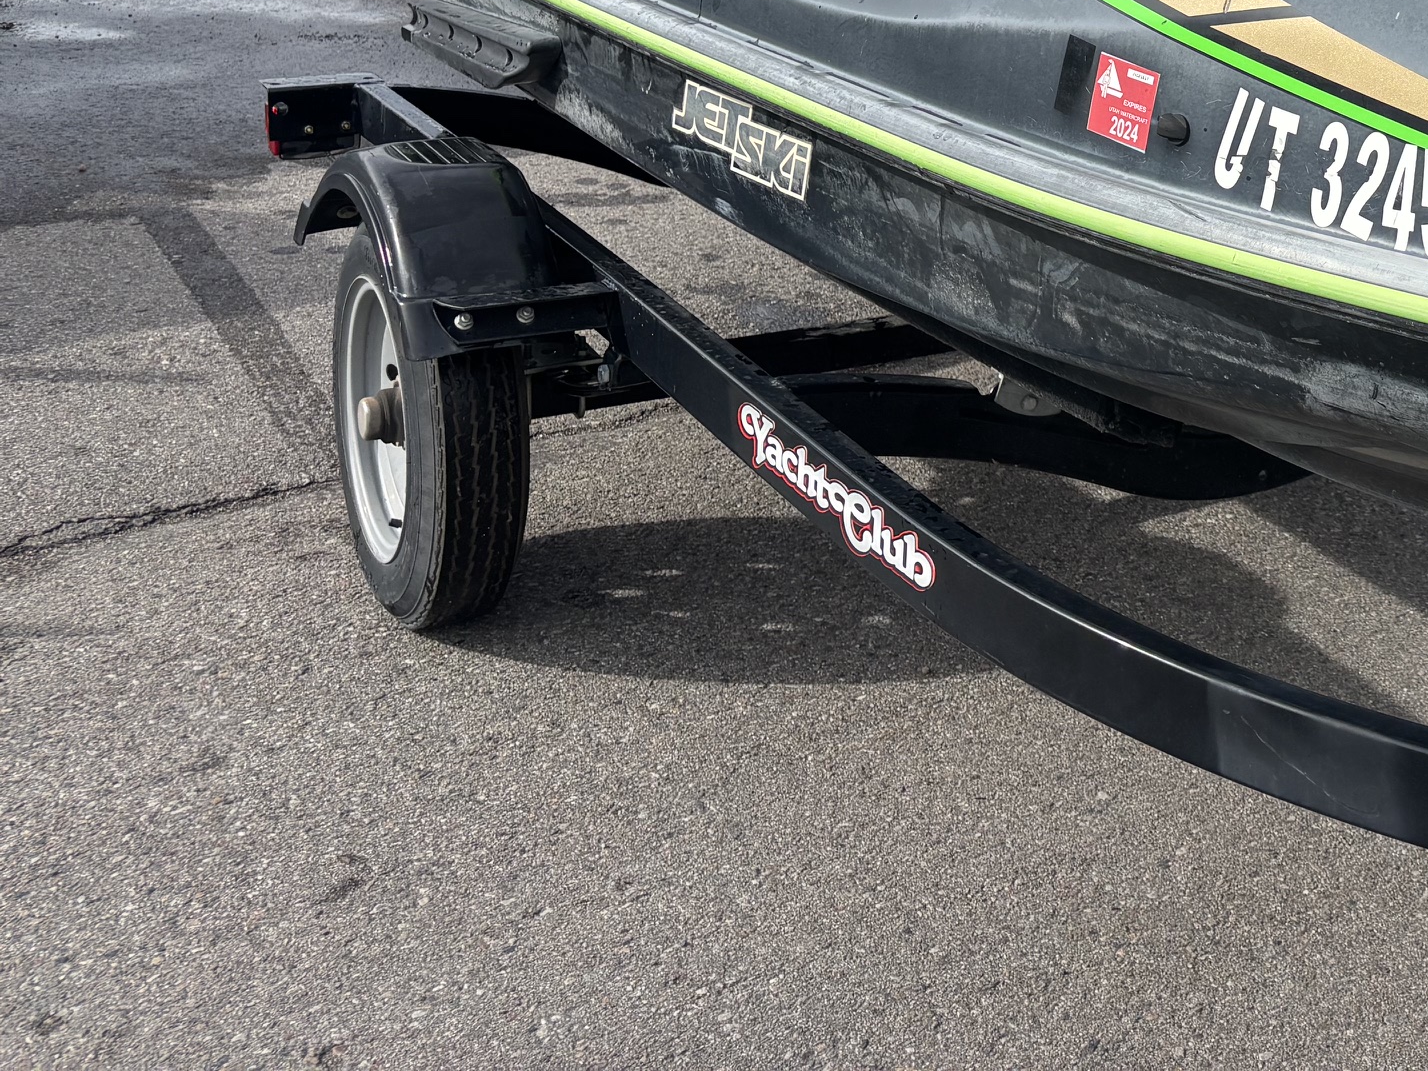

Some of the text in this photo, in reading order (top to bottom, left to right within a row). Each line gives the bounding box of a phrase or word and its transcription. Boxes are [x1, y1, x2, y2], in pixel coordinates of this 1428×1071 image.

[1120, 109, 1149, 125] WATERCRAFT
[1123, 99, 1147, 113] EXPIRES
[1109, 115, 1139, 143] 2024
[1214, 86, 1300, 212] UT
[738, 402, 936, 592] Yacht Club
